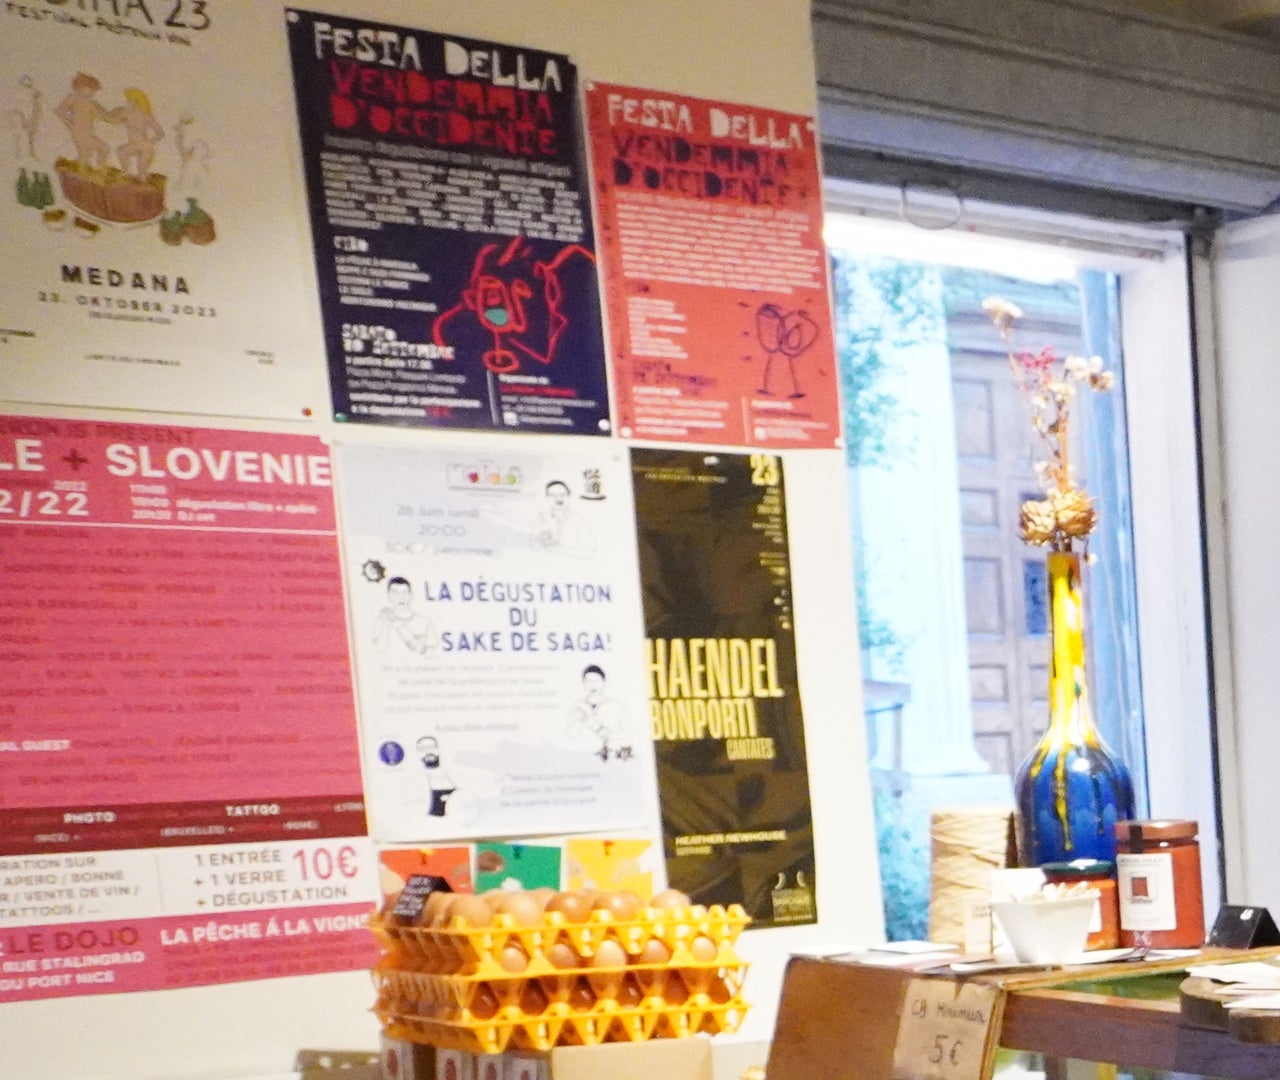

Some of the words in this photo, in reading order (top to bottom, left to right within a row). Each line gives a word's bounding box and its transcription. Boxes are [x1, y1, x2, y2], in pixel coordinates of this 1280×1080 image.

[312, 21, 422, 71] FESTA
[607, 93, 694, 134] FESTA
[61, 264, 190, 294] MEDANA
[105, 443, 333, 487] SLOVENIE
[424, 581, 451, 601] LA
[461, 576, 612, 602] DÉGUSTATION
[509, 607, 537, 627] DU
[441, 632, 502, 651] SAKE
[511, 632, 539, 651] DE
[548, 632, 612, 651] SAGA!
[644, 637, 784, 698] HAENDEL
[650, 697, 758, 741] BONPORTI
[675, 833, 724, 846] HEATHER
[726, 829, 787, 843] NEWHOUSE
[209, 849, 282, 867] ENTRÉE
[293, 846, 358, 881] 10€
[225, 869, 286, 885] VERRE
[212, 886, 347, 908] DÉGUSTATION
[8, 933, 43, 954] LE
[55, 926, 138, 951] DOJO
[161, 929, 188, 945] LA
[193, 921, 262, 943] PÊCHE
[285, 917, 309, 936] LA
[41, 951, 145, 971] STALINGRAD
[27, 973, 72, 988] PORT
[76, 970, 114, 984] NICE
[927, 1034, 963, 1067] 5€
